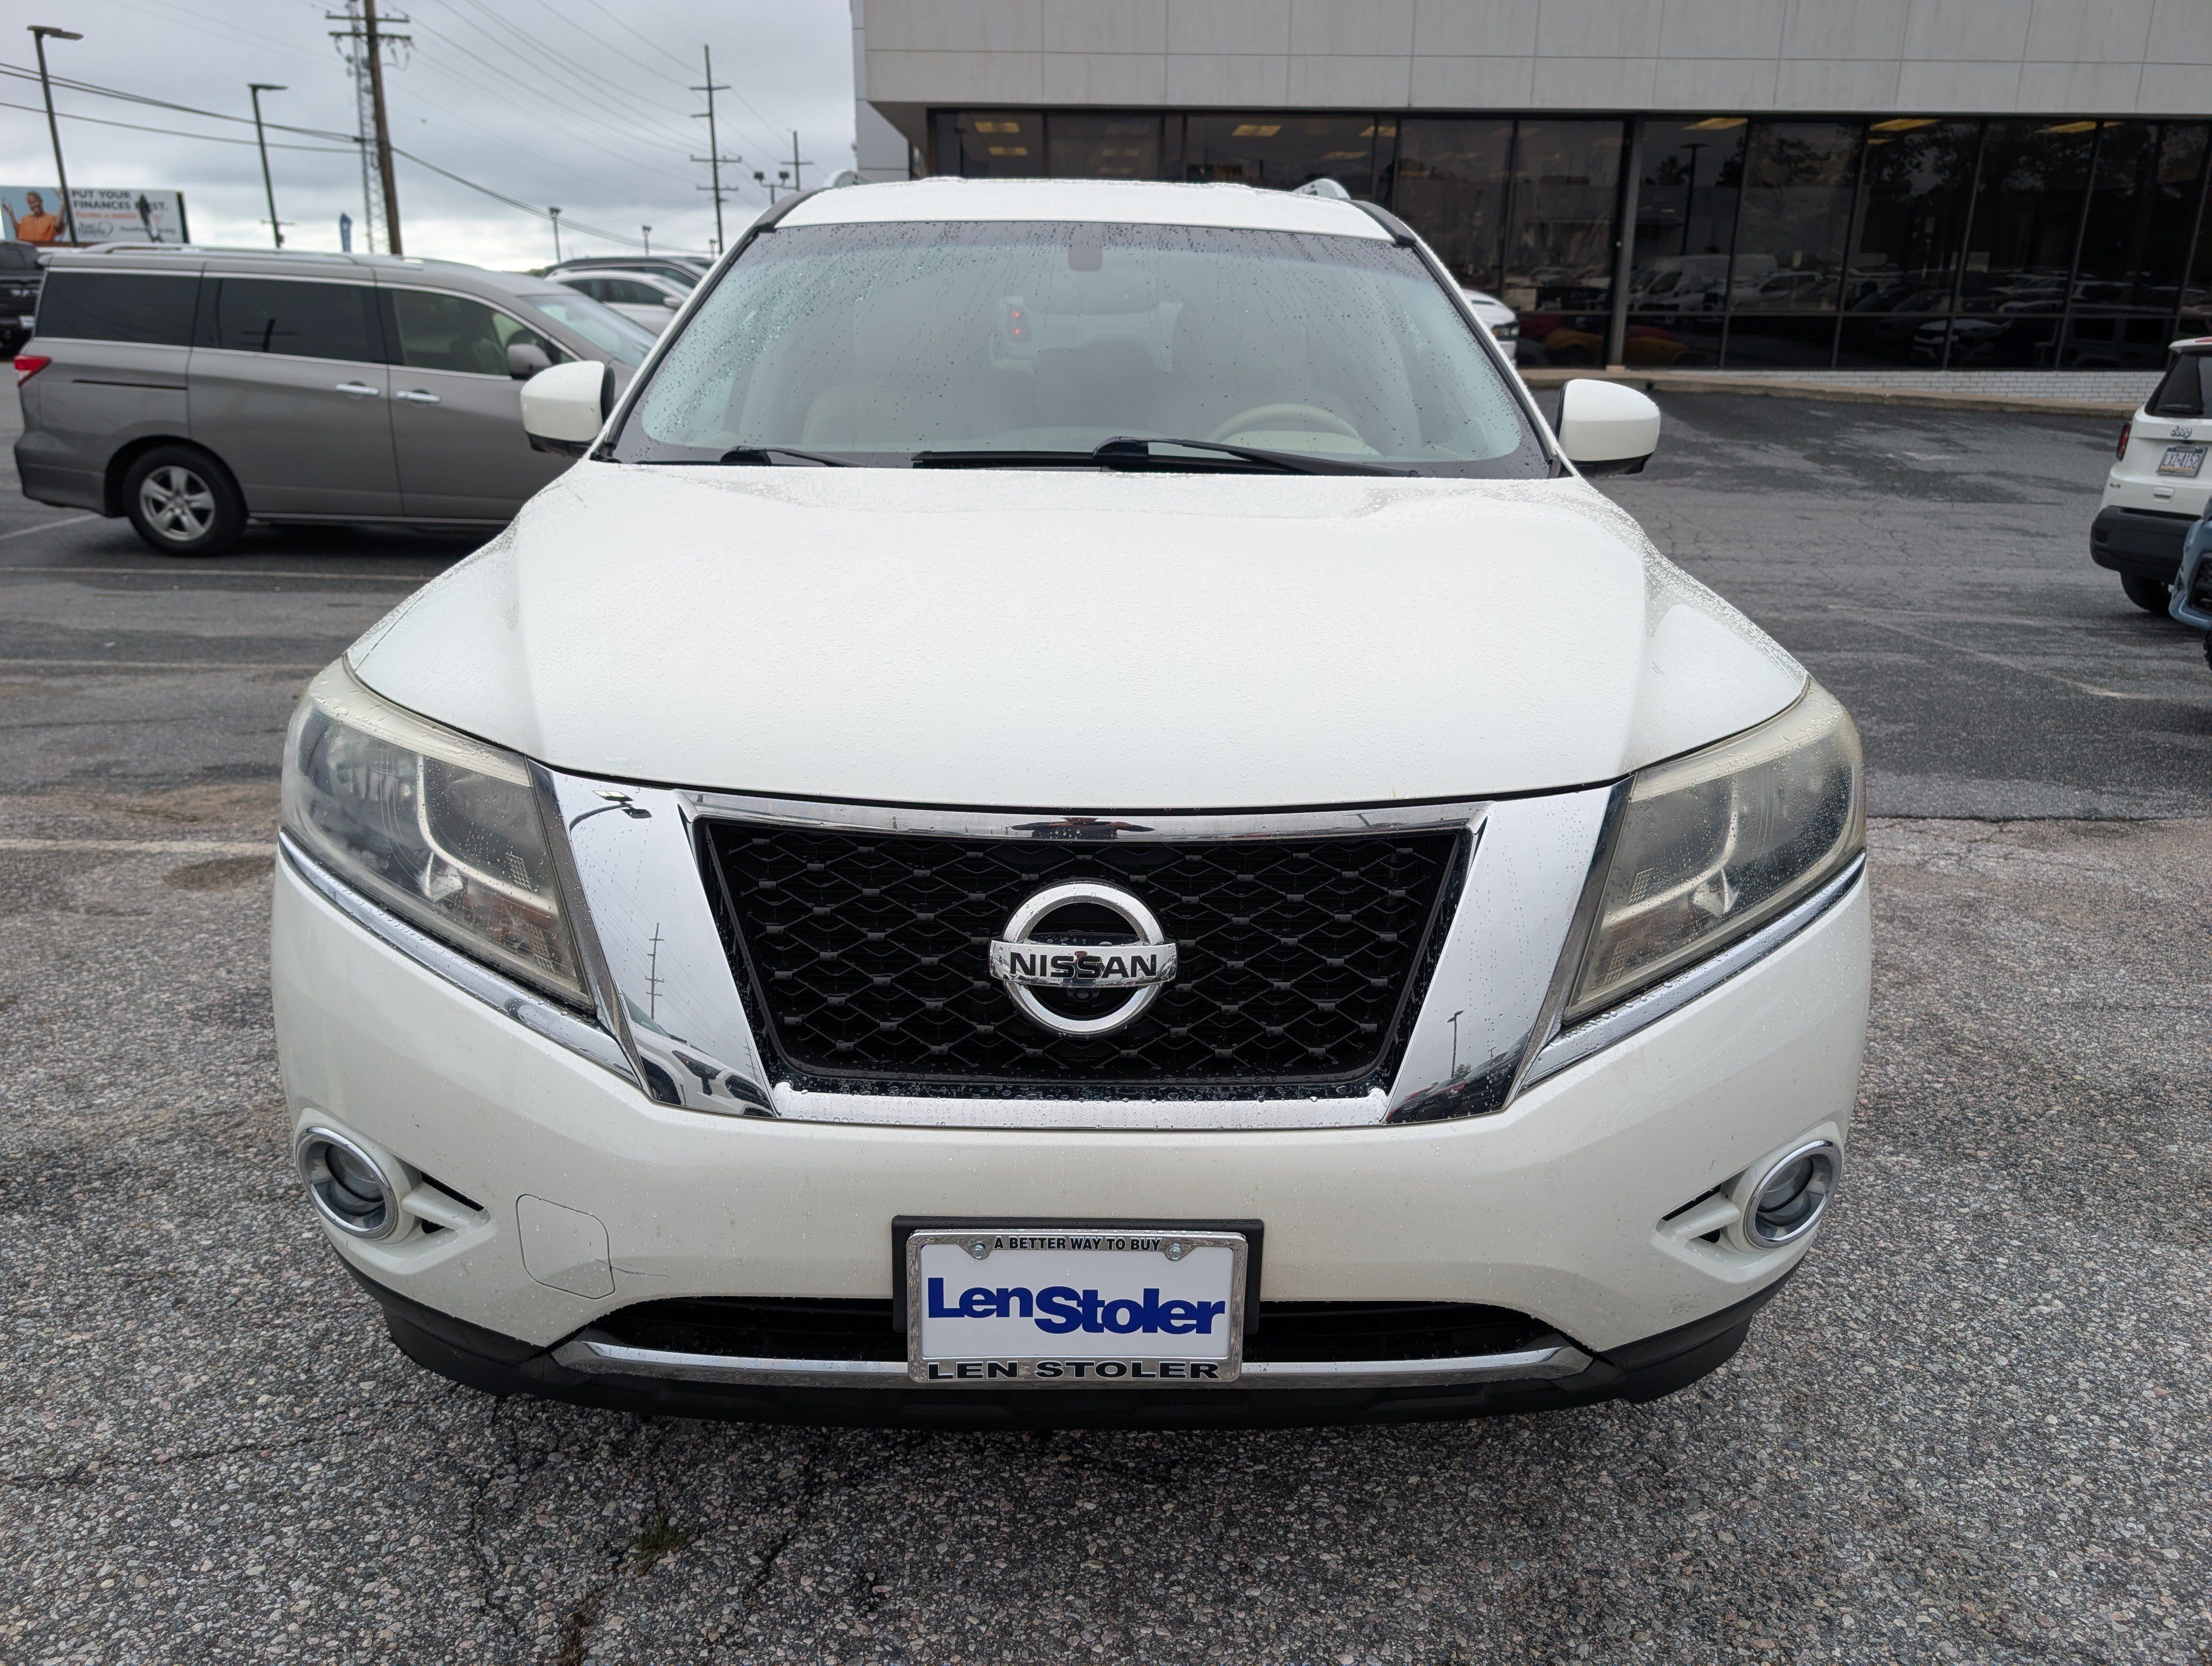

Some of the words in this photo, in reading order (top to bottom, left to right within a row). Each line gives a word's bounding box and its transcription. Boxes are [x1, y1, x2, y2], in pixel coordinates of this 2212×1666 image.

[72, 190, 94, 198] PUT
[100, 190, 131, 199] YOUR
[74, 201, 131, 210] FINANCES
[2171, 425, 2192, 439] Jeep
[1010, 951, 1158, 979] NISSAN
[994, 1235, 1005, 1250] A
[1008, 1235, 1066, 1250] BETTER
[1069, 1236, 1103, 1251] WAY
[1105, 1236, 1127, 1251] TO
[1130, 1236, 1162, 1251] BUY
[927, 1360, 1019, 1380] LEN
[1034, 1360, 1222, 1380] STOLER
